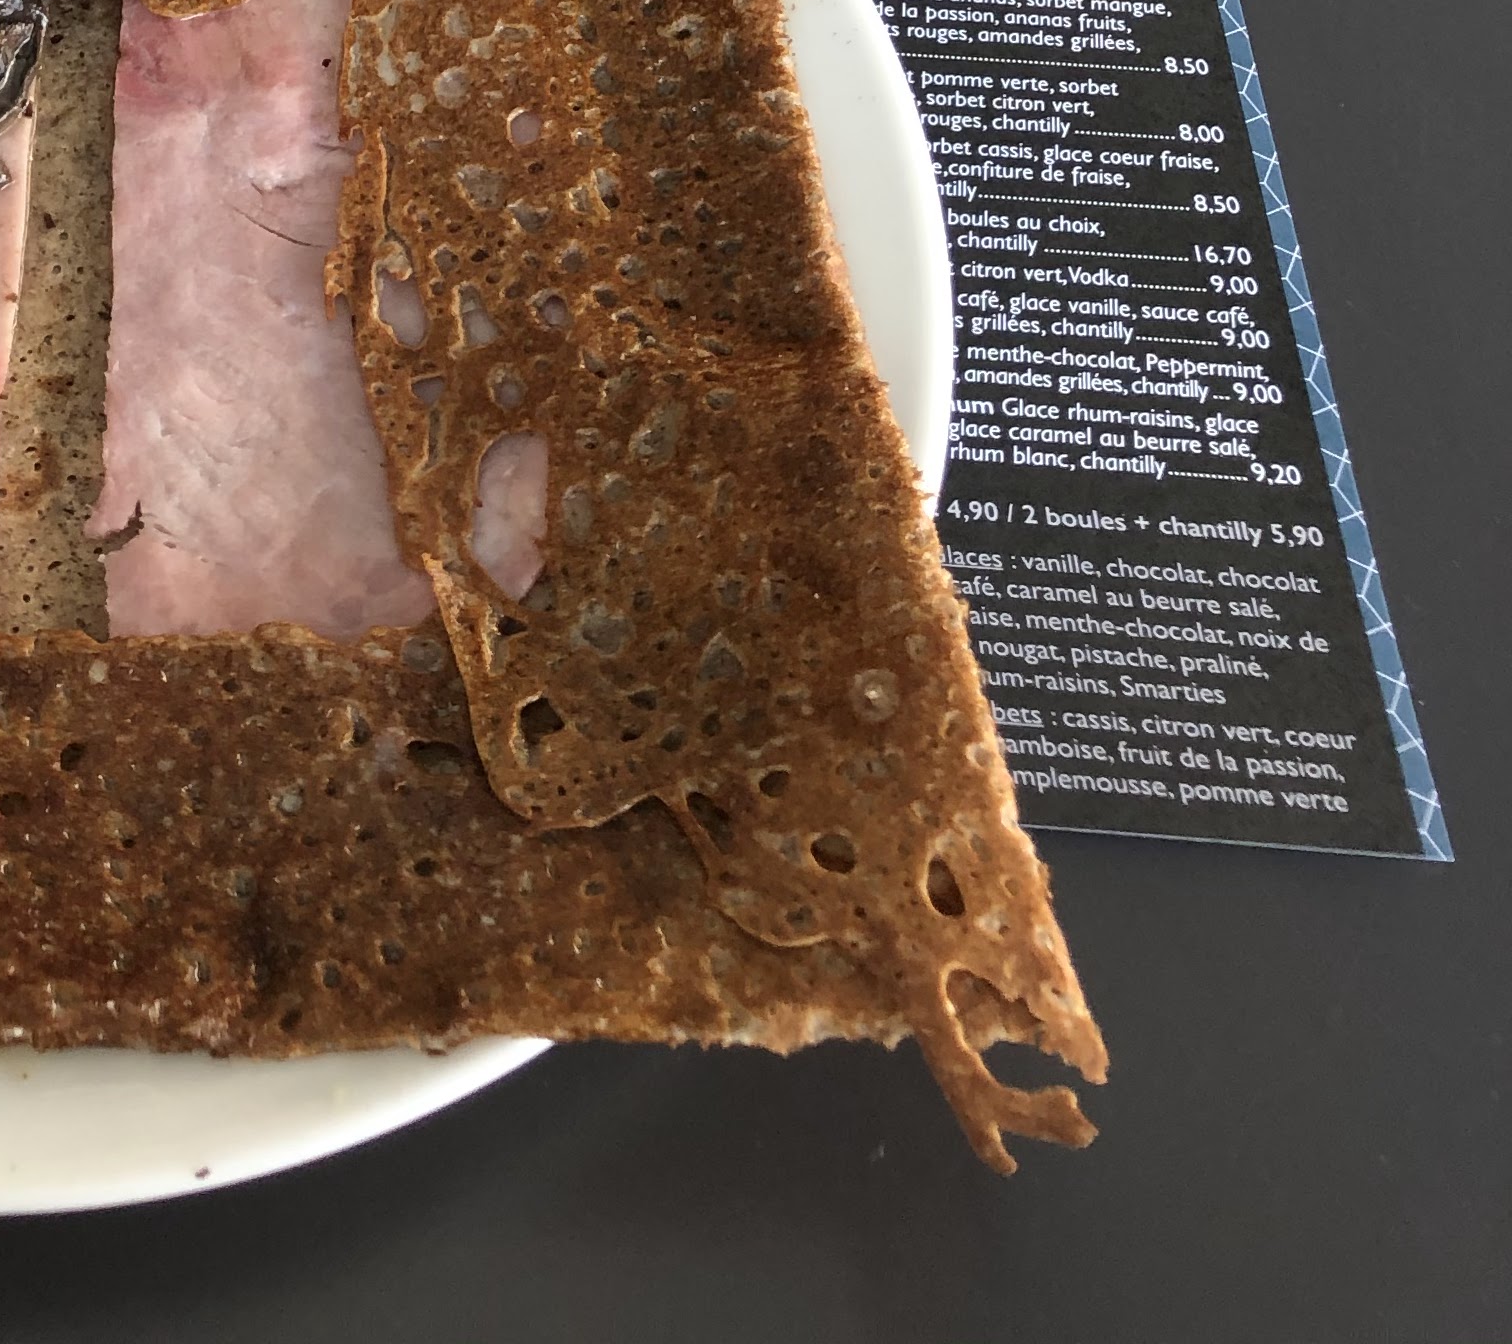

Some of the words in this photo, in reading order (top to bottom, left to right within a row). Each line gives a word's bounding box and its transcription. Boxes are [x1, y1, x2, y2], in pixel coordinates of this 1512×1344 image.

[1193, 243, 1252, 267] 16,70
[957, 288, 1004, 313] café,
[1010, 291, 1061, 319] glace
[1068, 296, 1137, 320] vanille,
[1141, 303, 1199, 323] sauce
[1206, 304, 1255, 327] café,
[967, 340, 1141, 372] menthe-chocolat,
[1146, 353, 1269, 383] Peppermint,
[1233, 382, 1283, 407] 9,00
[947, 498, 999, 525] 4,90
[1021, 503, 1039, 525] 2
[1045, 505, 1127, 533] boules
[1159, 515, 1262, 547] chantilly
[1269, 523, 1324, 549] 5,90
[1021, 551, 1102, 578] vanille,
[1106, 557, 1214, 587] chocolat,
[1218, 566, 1321, 595] chocolat
[979, 640, 1065, 667] nougat,
[1071, 642, 1175, 674] pistache,
[1180, 653, 1269, 682] praliné,
